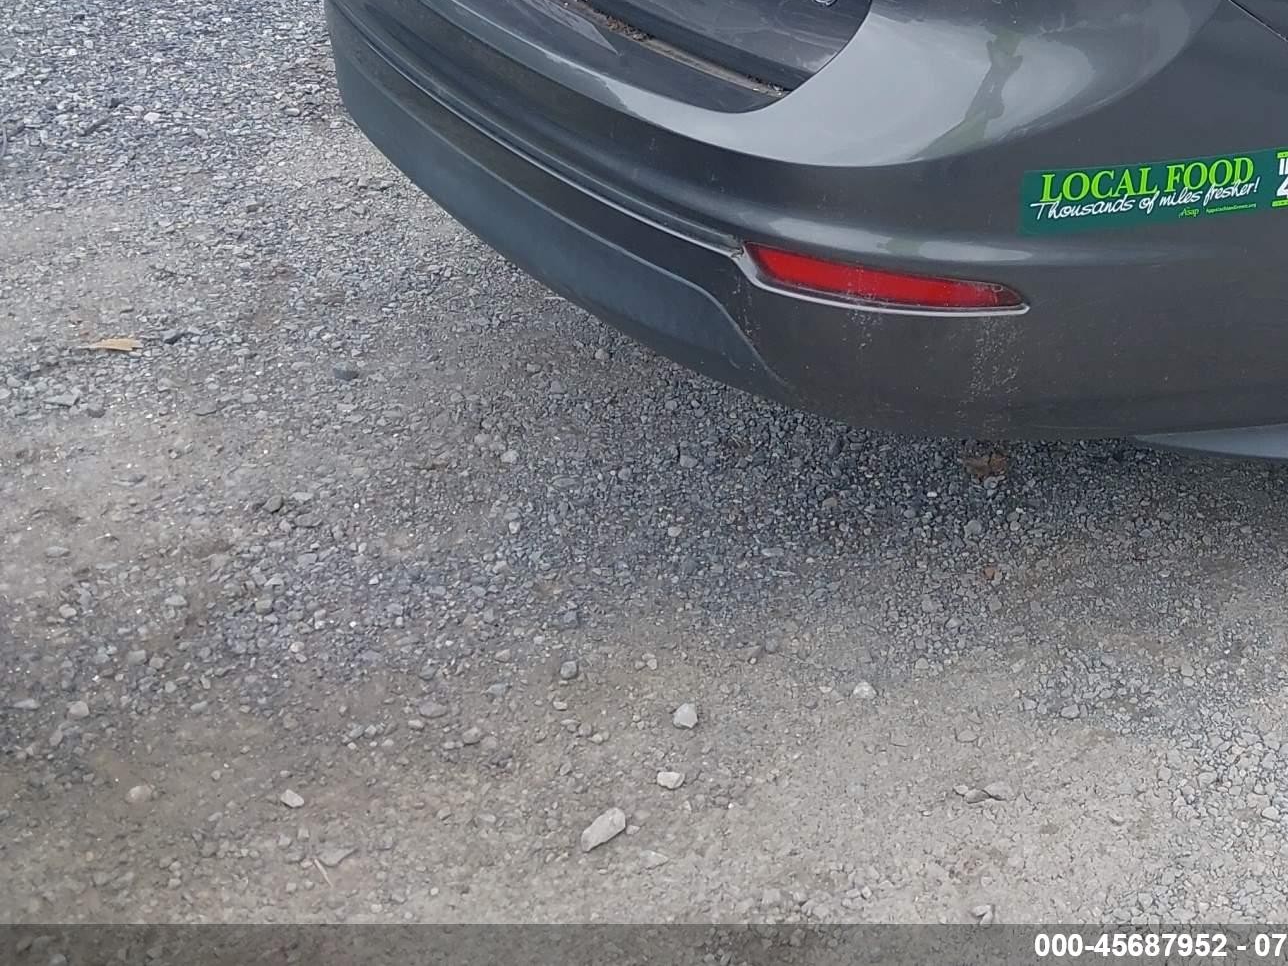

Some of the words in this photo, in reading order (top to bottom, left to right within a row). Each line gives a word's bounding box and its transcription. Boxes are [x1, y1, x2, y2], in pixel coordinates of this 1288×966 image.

[1030, 193, 1136, 221] Thousands
[1138, 189, 1160, 215] of
[1159, 186, 1203, 208] miles
[1202, 176, 1261, 207] fresher!
[1039, 166, 1158, 203] LOCAL
[1164, 156, 1255, 193] FOOD
